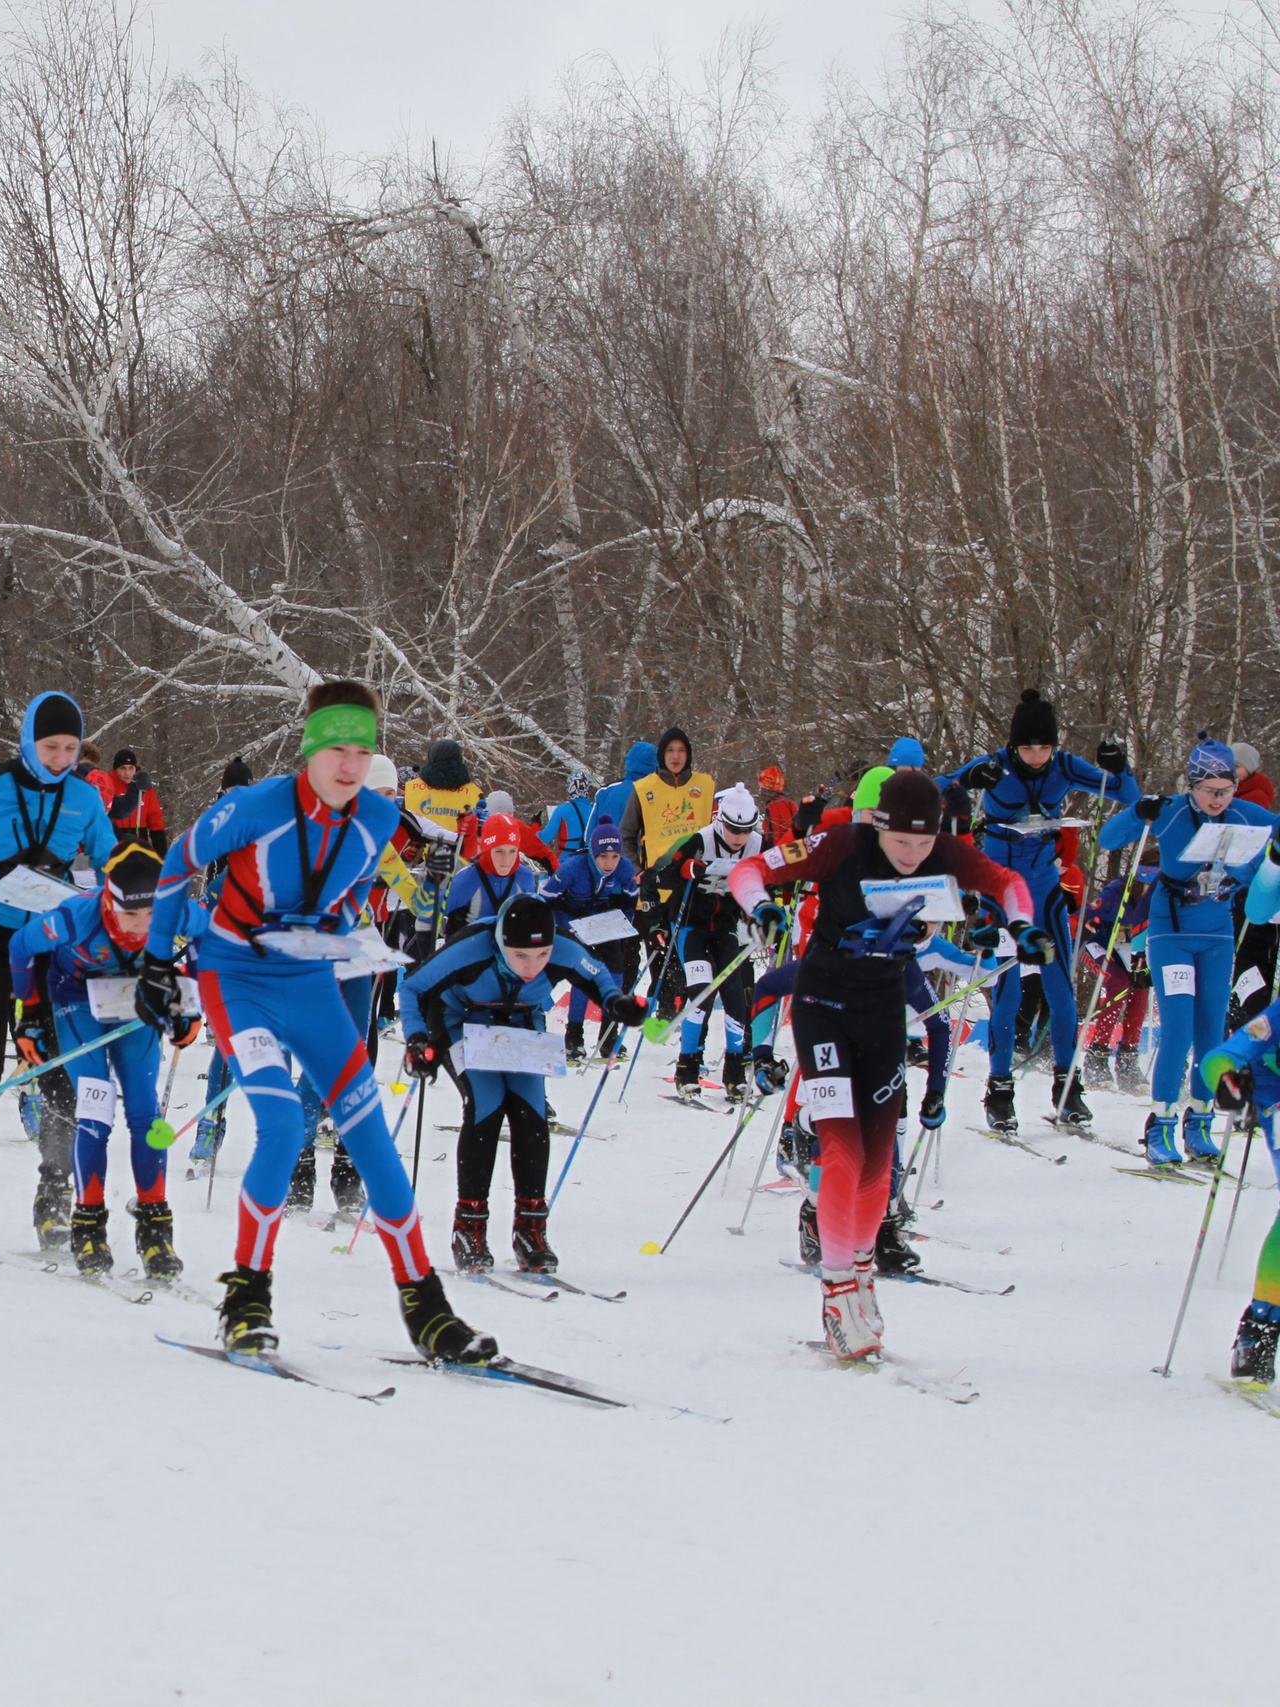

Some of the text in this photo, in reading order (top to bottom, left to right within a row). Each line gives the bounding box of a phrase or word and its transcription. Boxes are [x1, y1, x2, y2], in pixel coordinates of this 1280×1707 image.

[598, 837, 620, 846] RUSSIA
[871, 881, 941, 893] MAGNETO
[1172, 972, 1189, 980] 723
[85, 1087, 108, 1102] 707
[811, 1086, 837, 1099] 706
